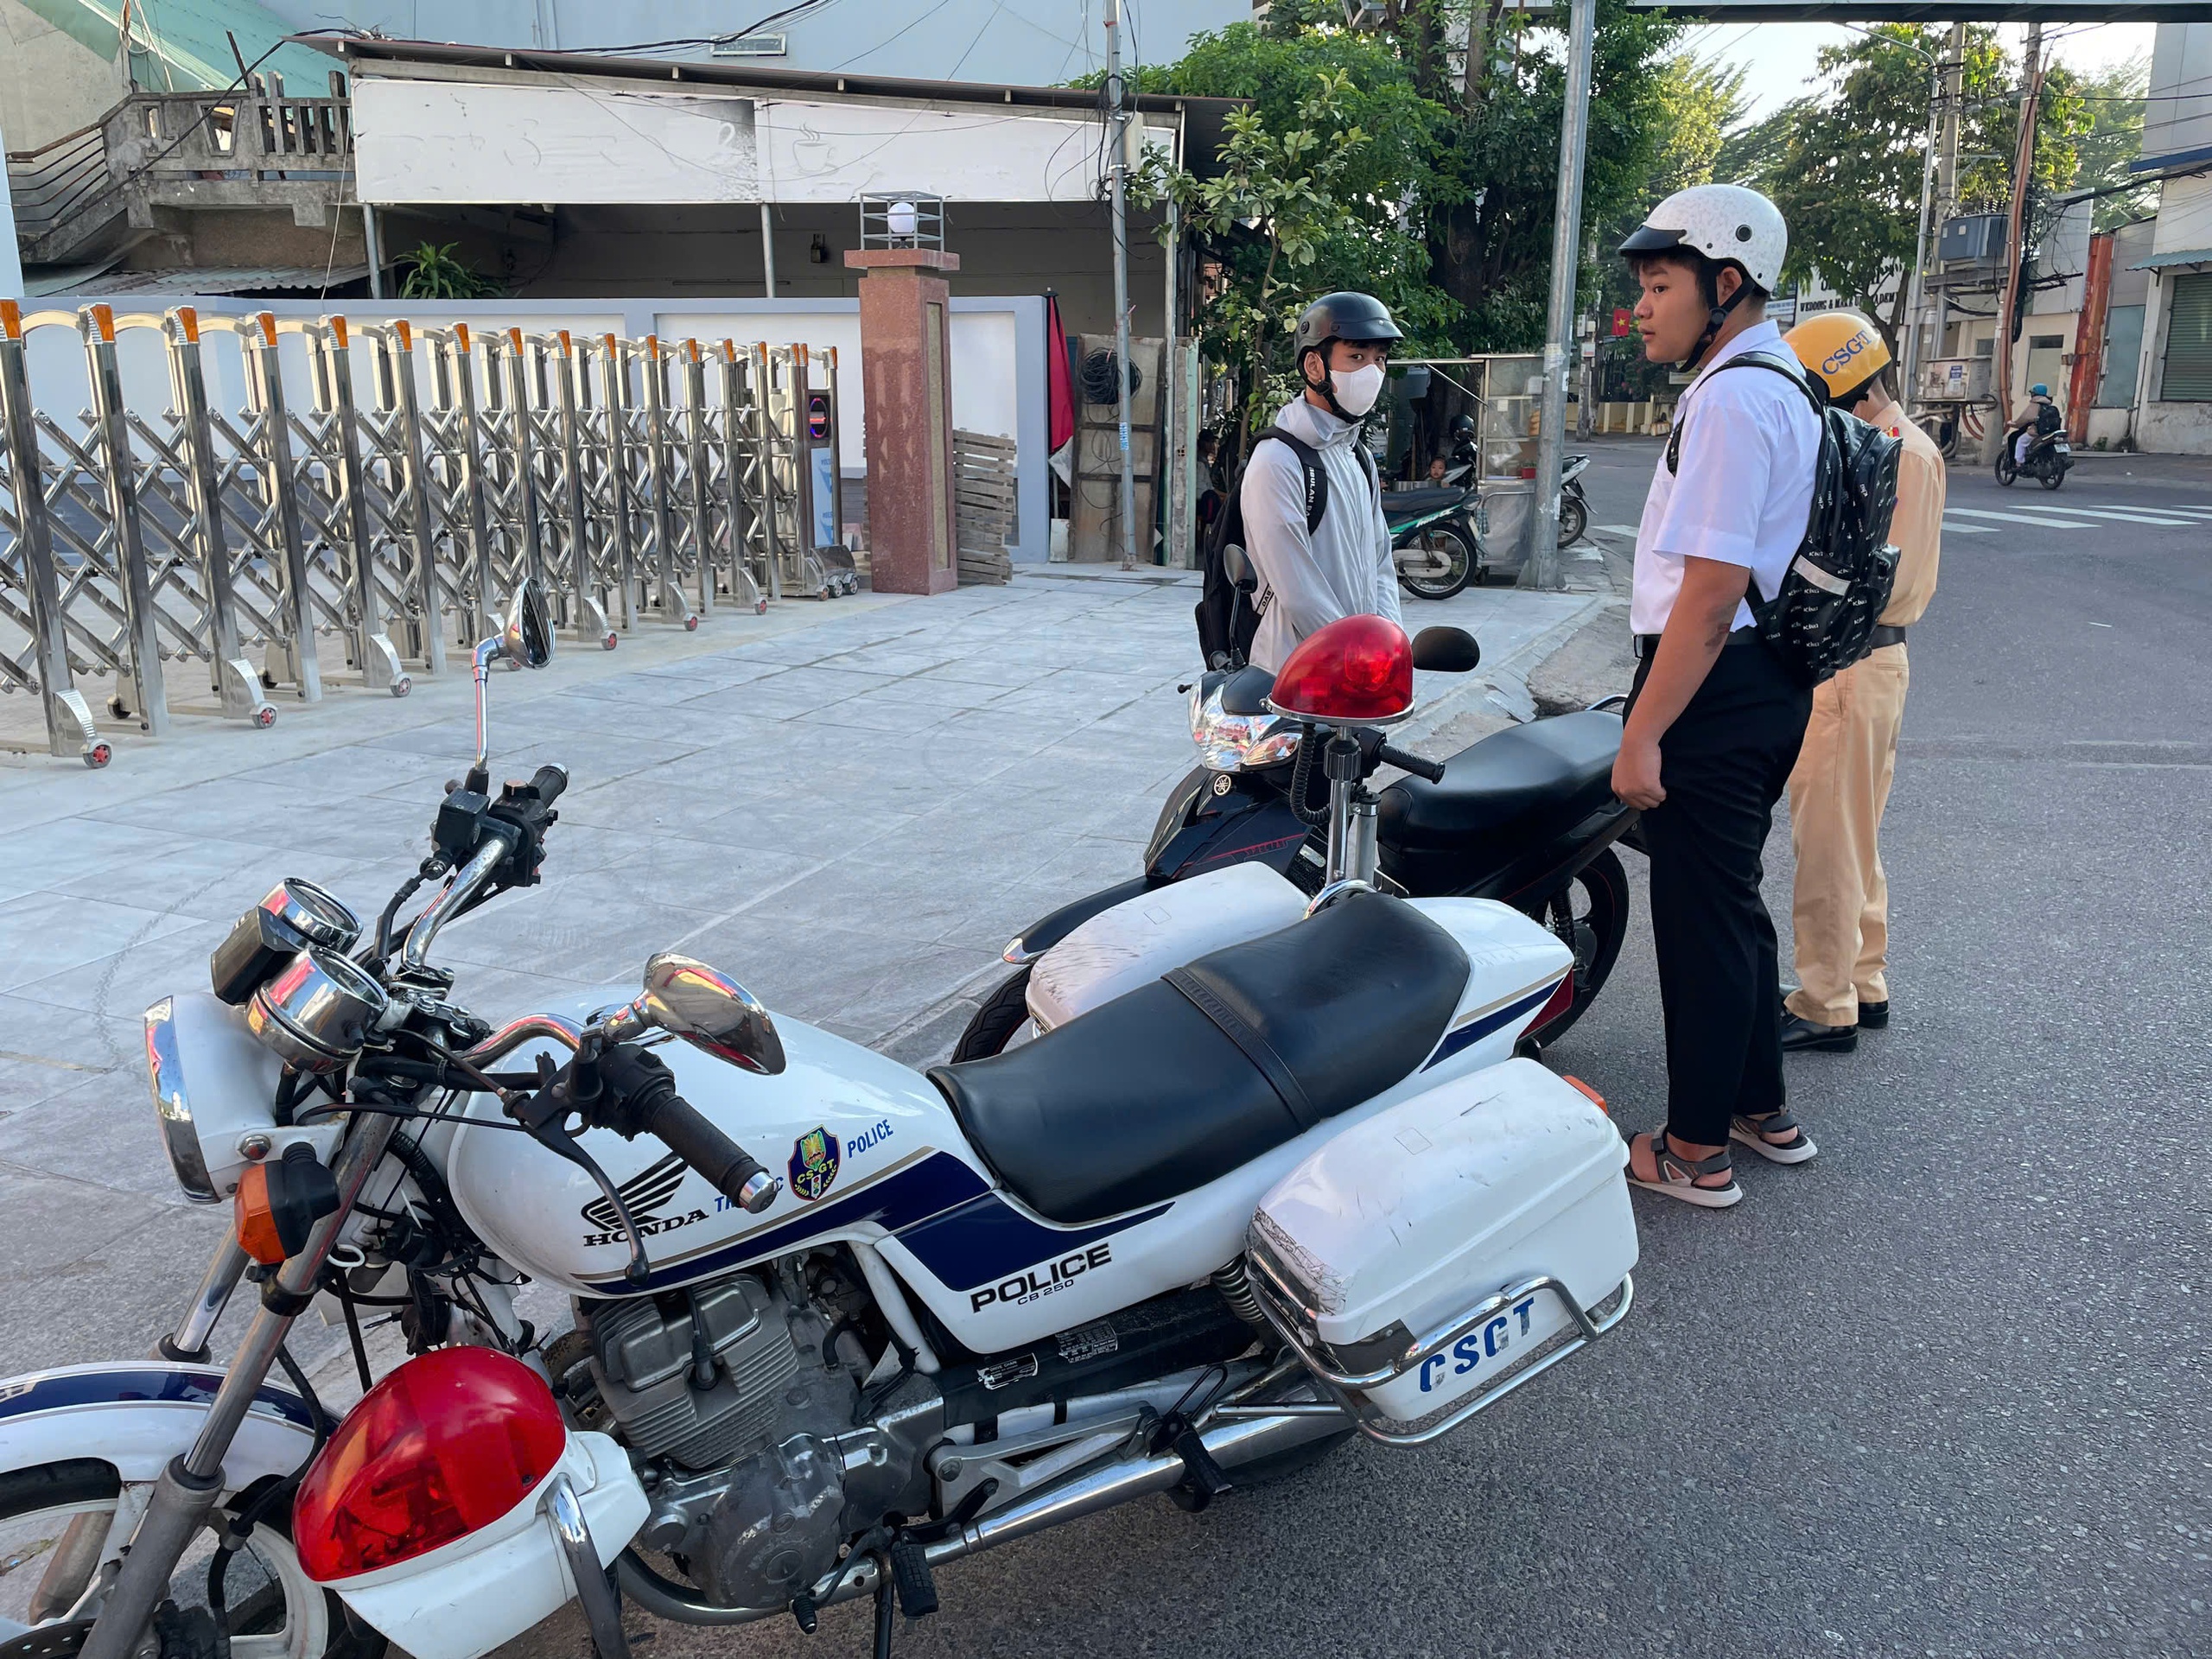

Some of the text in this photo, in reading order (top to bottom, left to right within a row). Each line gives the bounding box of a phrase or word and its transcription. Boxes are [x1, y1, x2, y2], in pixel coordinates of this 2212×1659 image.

[1821, 330, 1872, 375] CSGT
[848, 1118, 894, 1159] POLICE
[583, 1209, 709, 1247] HONDA
[969, 1242, 1112, 1313] POLICE
[1017, 1279, 1074, 1306] CB 250
[1420, 1297, 1535, 1392] CSGT
